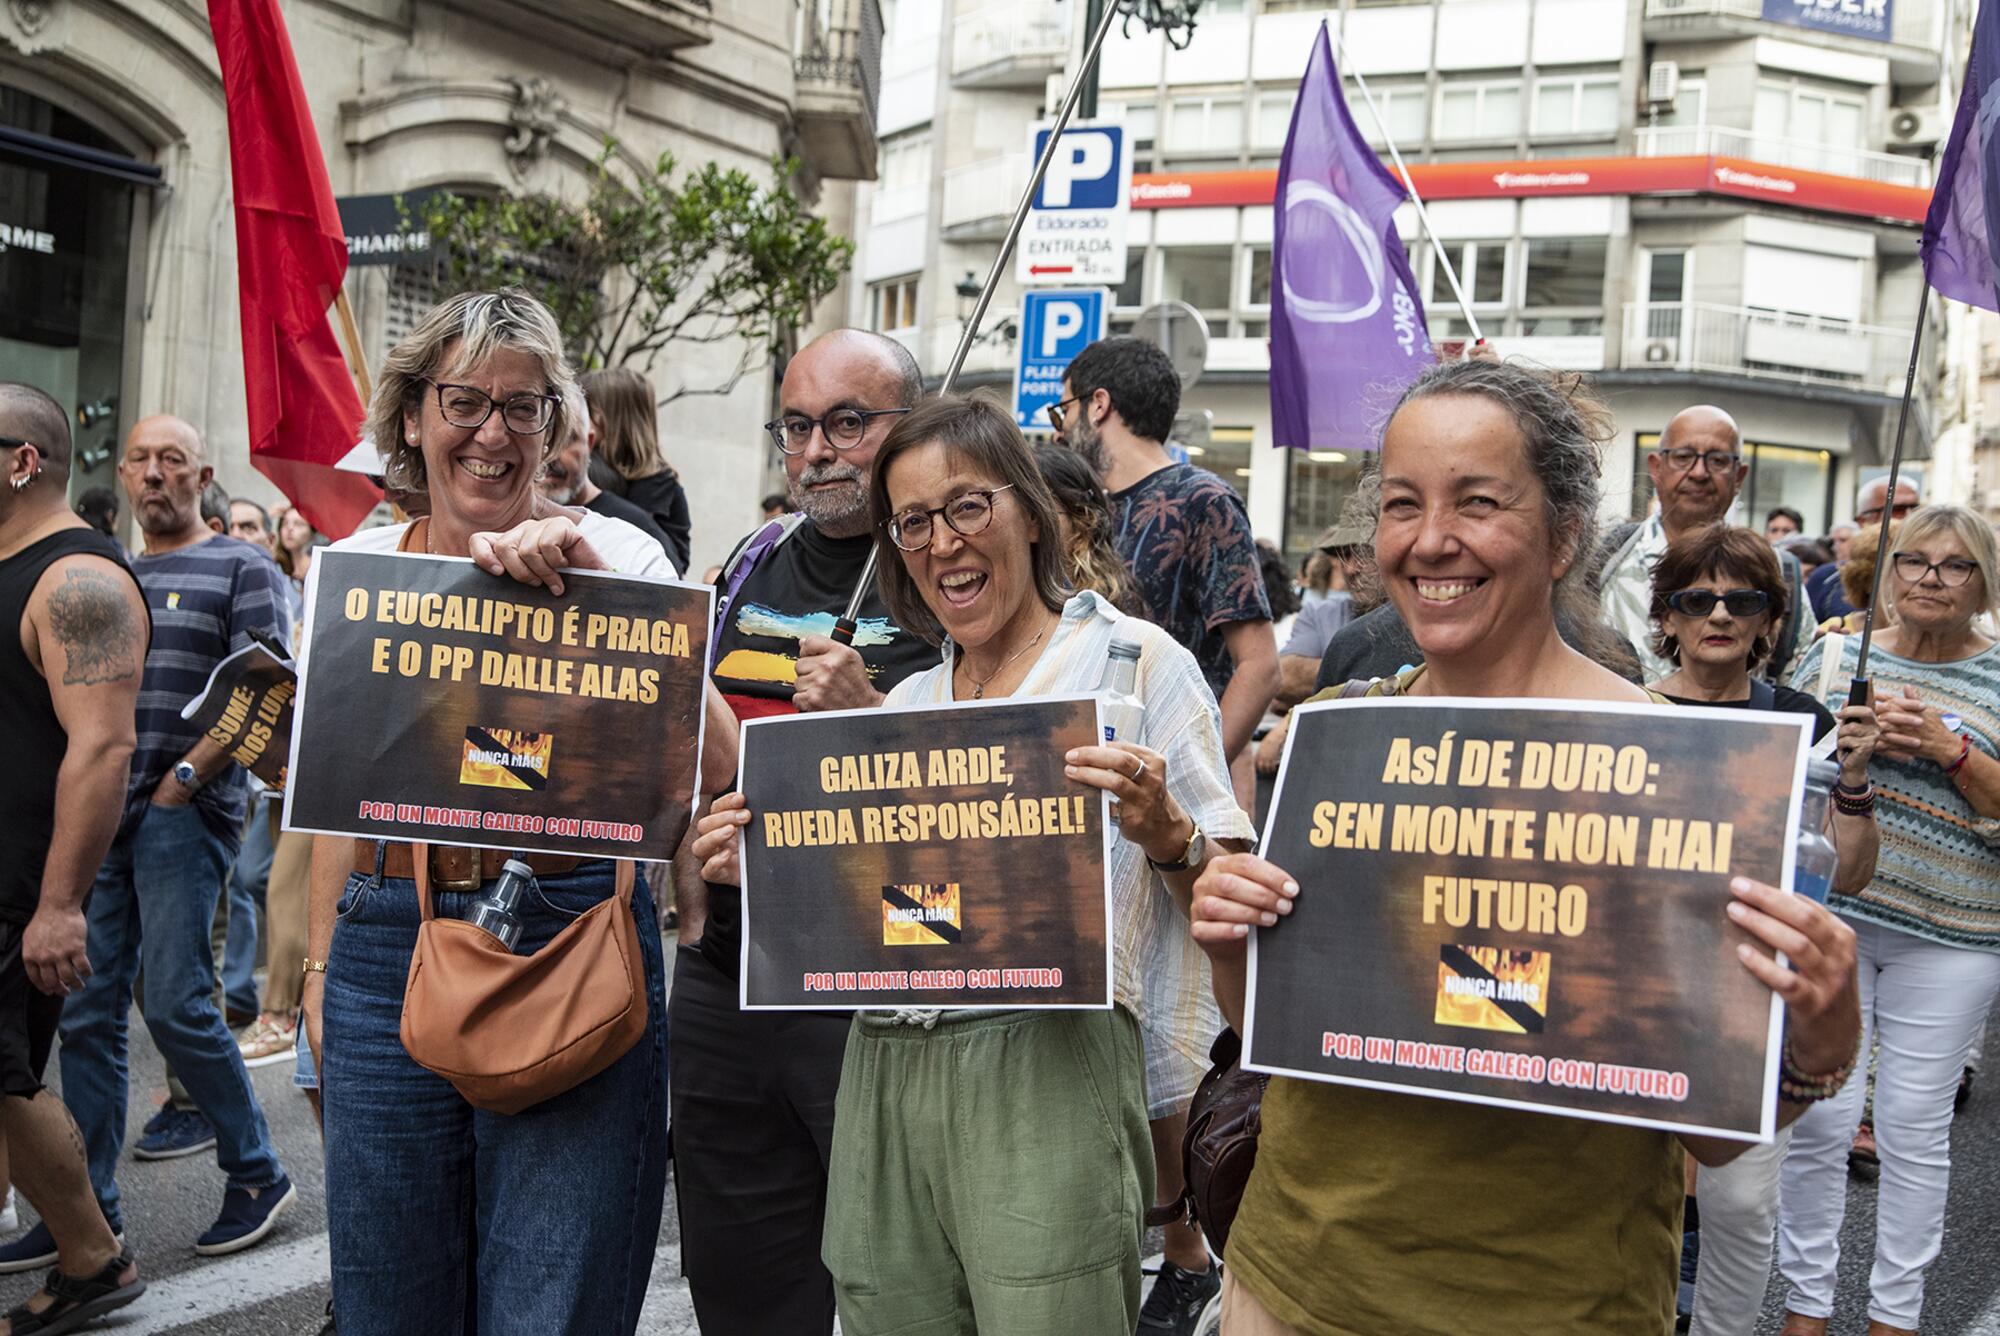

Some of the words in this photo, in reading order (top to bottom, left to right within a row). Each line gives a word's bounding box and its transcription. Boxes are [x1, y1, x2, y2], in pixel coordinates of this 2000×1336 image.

[1042, 131, 1113, 207] P
[1028, 237, 1113, 254] ENTRADA
[1037, 215, 1109, 231] Eldorado
[1042, 301, 1084, 356] P
[345, 587, 369, 621] O
[376, 589, 554, 643] EUCALIPTO
[561, 605, 580, 647] É
[586, 613, 690, 658] PRAGA
[371, 637, 391, 673] E
[398, 640, 422, 677] O
[429, 643, 474, 682] PP
[480, 650, 574, 695] DALLE
[579, 663, 660, 705] ALAS
[205, 685, 256, 748] SUME:
[468, 748, 509, 766] NUNCA
[820, 751, 922, 793] GALIZA
[928, 745, 1014, 787] ARDE,
[1458, 739, 1514, 788] DE
[1520, 741, 1660, 796] DURO:
[360, 801, 395, 821] POR
[397, 804, 422, 824] UN
[423, 807, 481, 829] MONTE
[482, 811, 544, 834] GALEGO
[545, 816, 580, 837] CON
[581, 820, 643, 842] FUTURO
[764, 808, 858, 848] RUEDA
[861, 792, 1086, 844] RESPONSÁBEL!
[1309, 800, 1385, 850] SEN
[1391, 804, 1536, 861] MONTE
[1544, 811, 1640, 867] NON
[1647, 817, 1734, 874] HAI
[888, 908, 925, 922] NUNCA
[1422, 875, 1588, 937] FUTURO
[804, 972, 834, 991] POR
[835, 972, 857, 991] UN
[858, 971, 908, 990] MONTE
[909, 970, 966, 989] GALEGO
[967, 969, 1000, 988] CON
[1001, 967, 1063, 988] FUTURO
[1445, 975, 1496, 999] NUNCA
[1322, 1031, 1363, 1061] POR
[1364, 1036, 1395, 1065] UN
[1395, 1040, 1466, 1073] MONTE
[1466, 1049, 1547, 1083] GALEGO
[1547, 1057, 1596, 1089] CON
[1596, 1063, 1689, 1101] FUTURO
